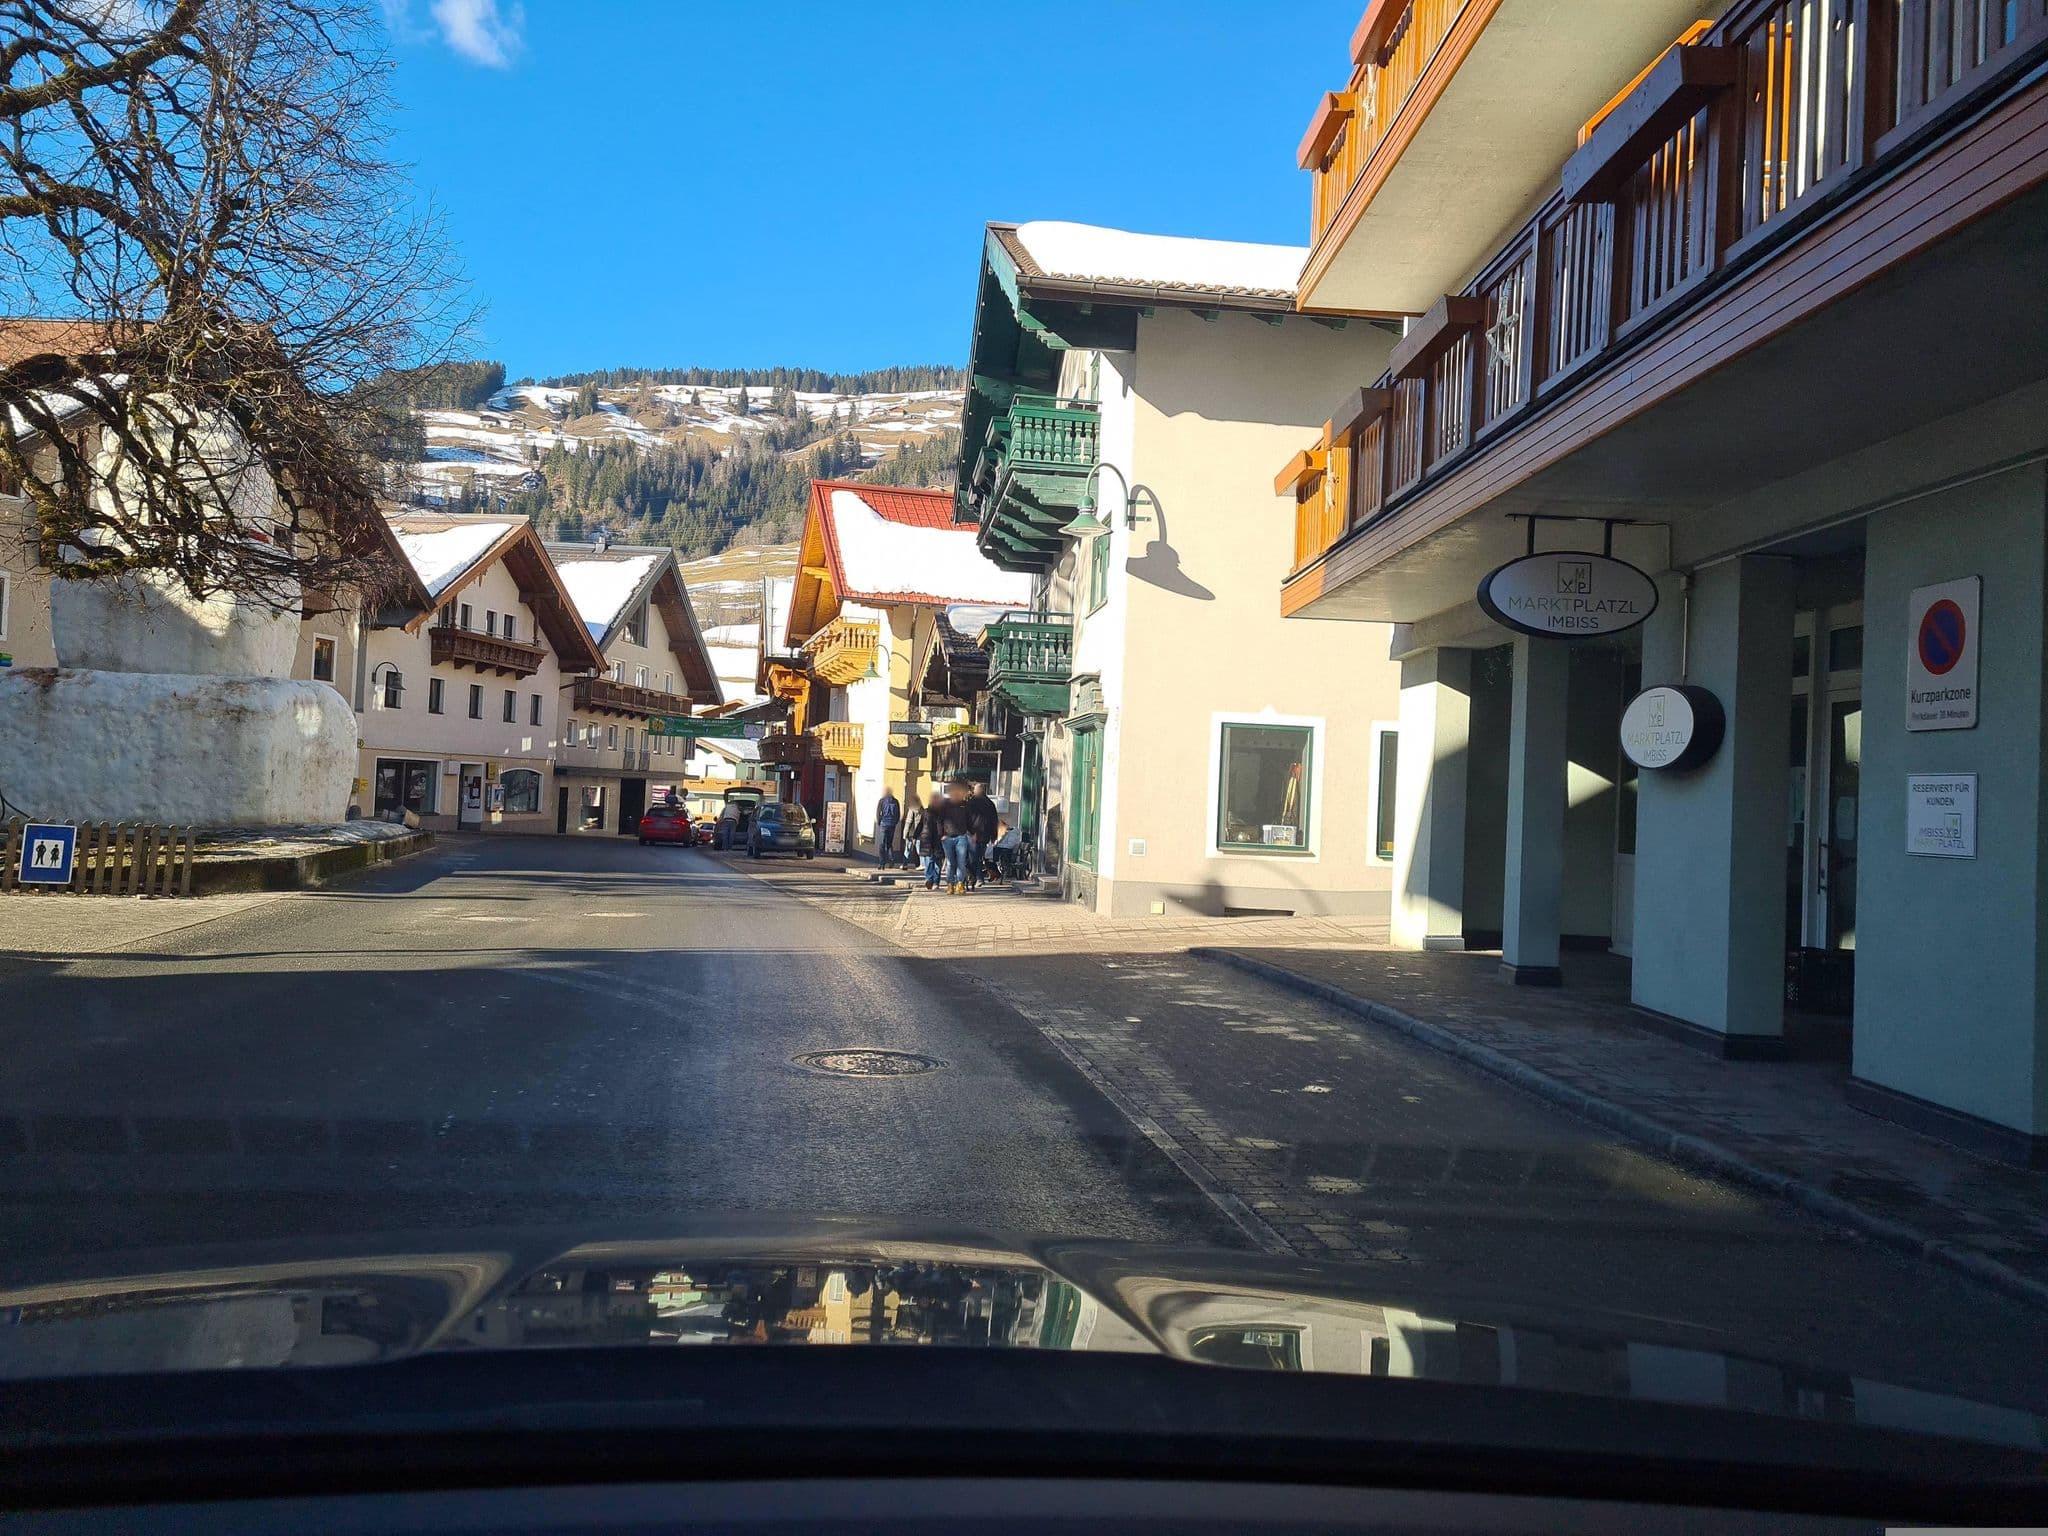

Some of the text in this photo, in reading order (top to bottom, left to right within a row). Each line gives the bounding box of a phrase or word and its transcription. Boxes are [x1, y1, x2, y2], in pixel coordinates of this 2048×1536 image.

[1508, 596, 1640, 614] MARKTPLATZL
[1547, 615, 1599, 629] IMBISS
[1911, 687, 1971, 705] Kurzparkzone
[1627, 730, 1686, 745] MARKTPLATZL
[1643, 749, 1667, 761] IMBISS
[1912, 781, 1970, 793] RESERVIERT FÜR
[1926, 797, 1955, 807] KUNDEN
